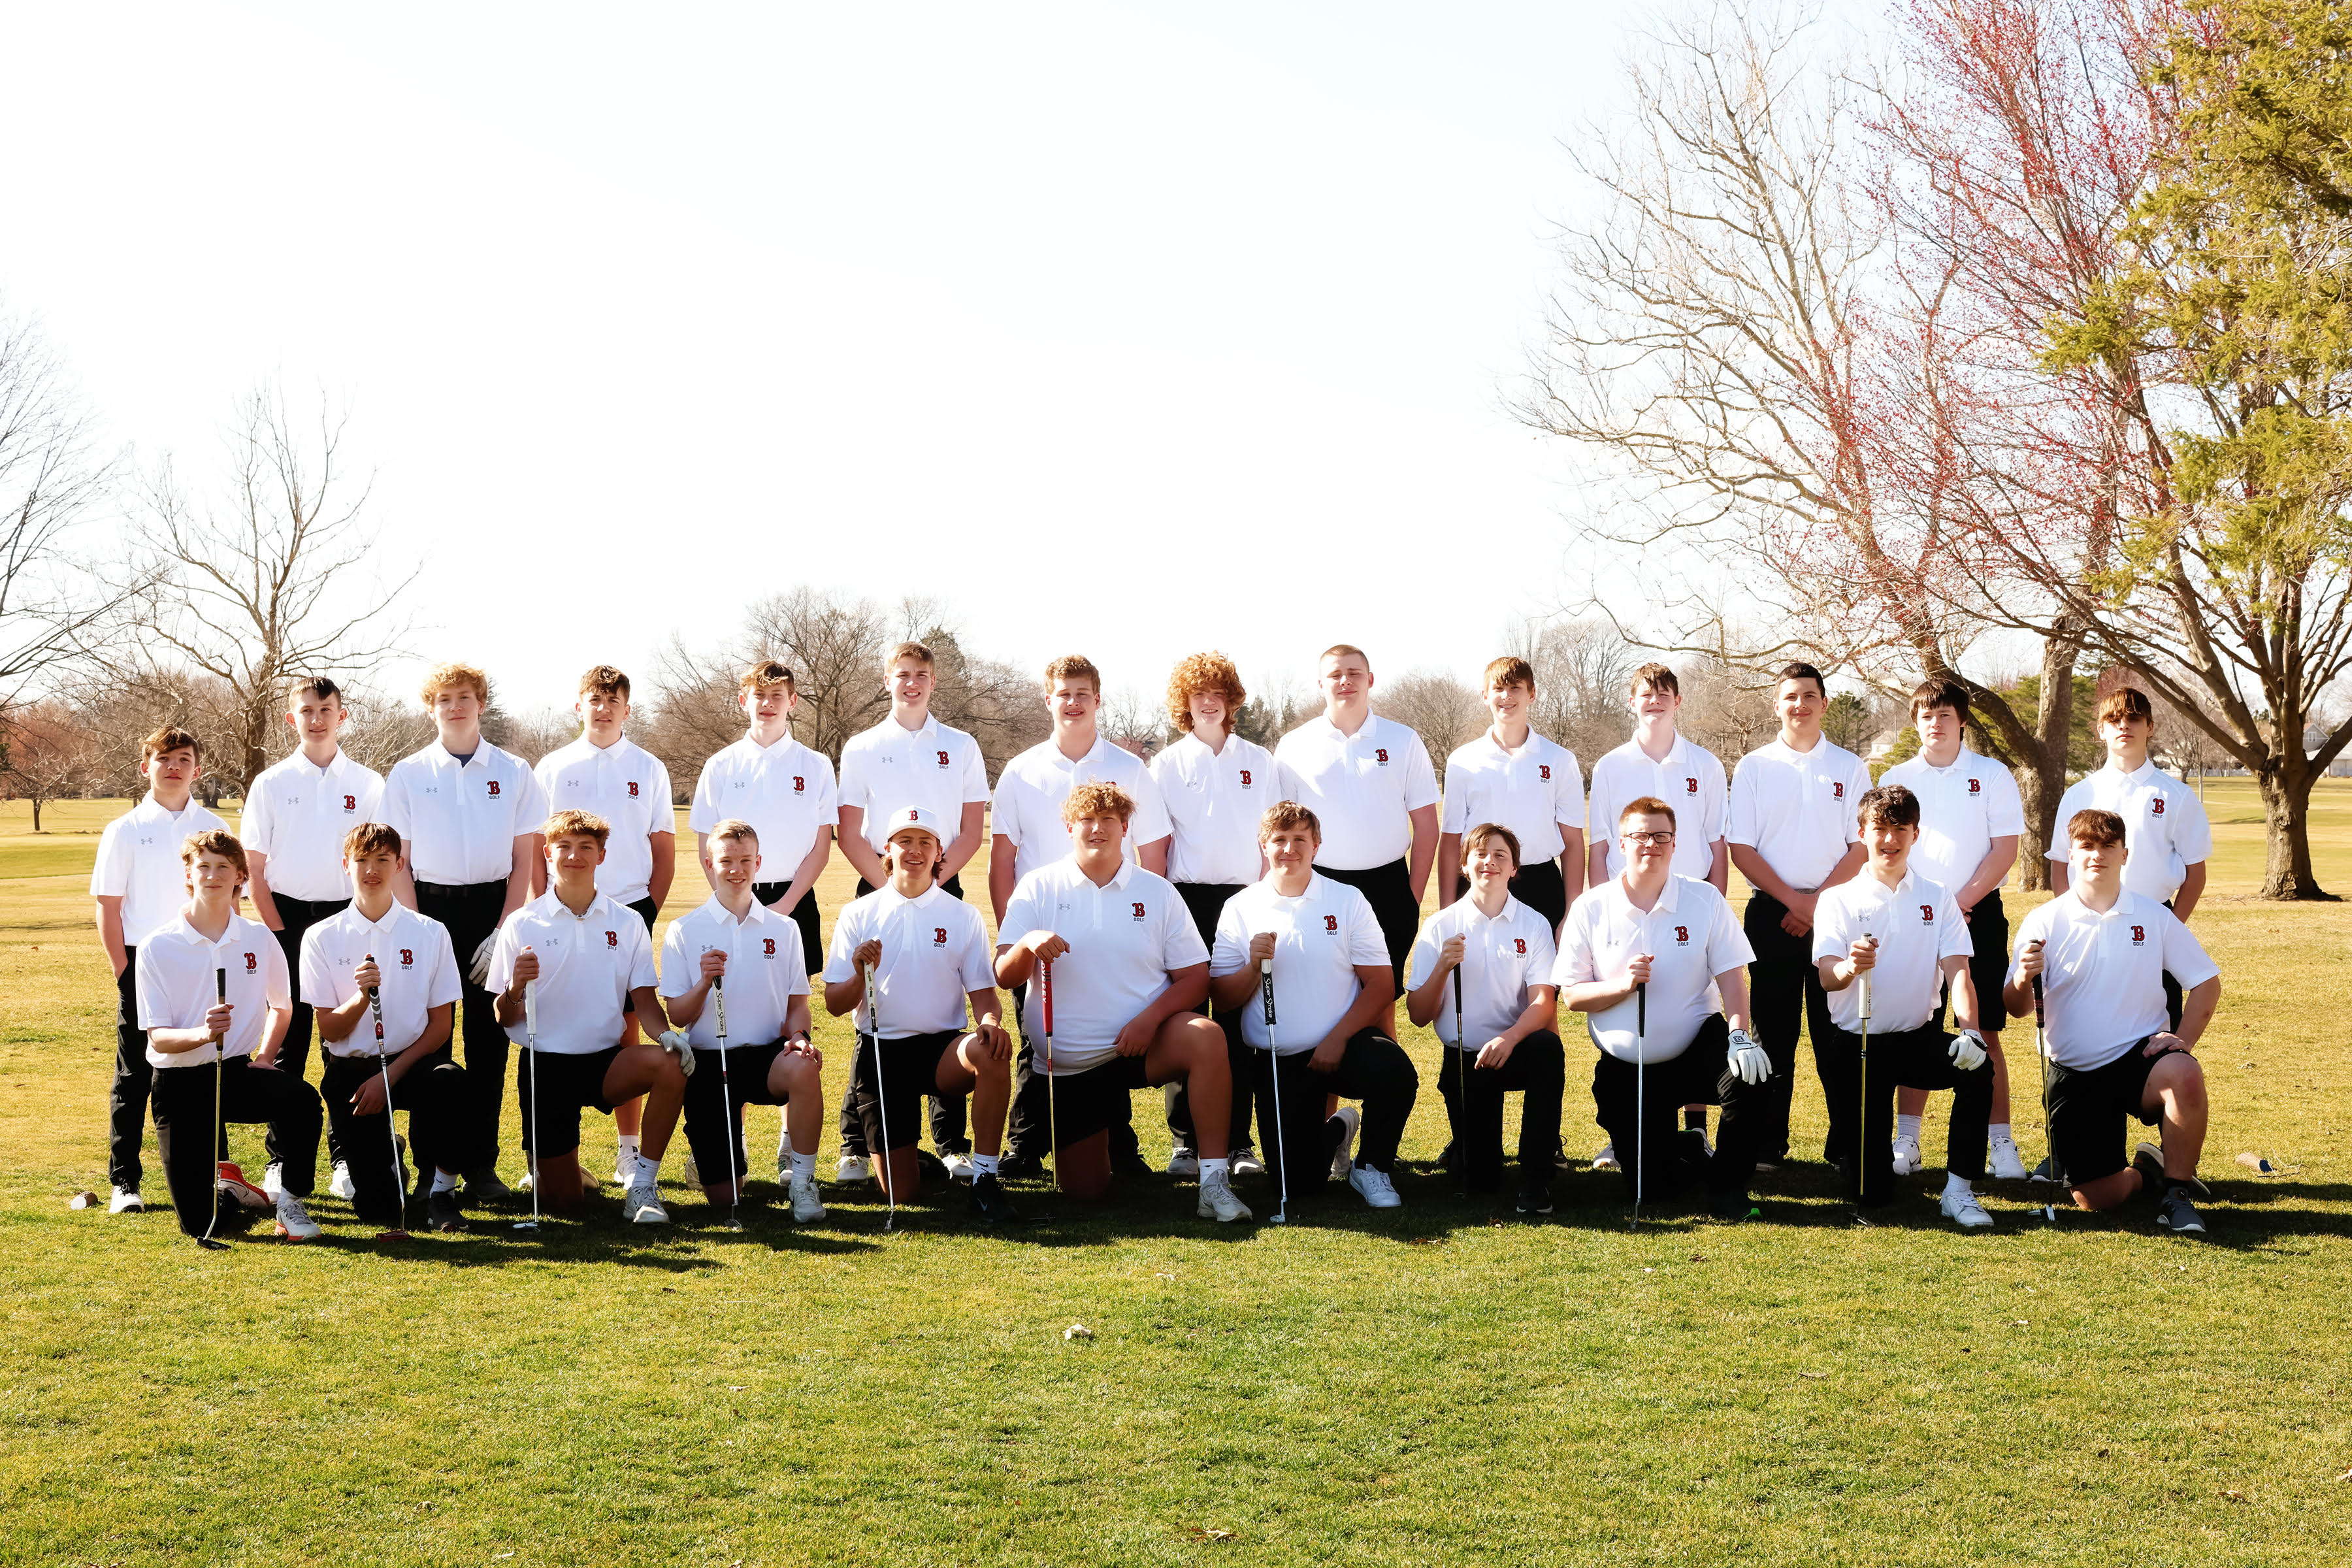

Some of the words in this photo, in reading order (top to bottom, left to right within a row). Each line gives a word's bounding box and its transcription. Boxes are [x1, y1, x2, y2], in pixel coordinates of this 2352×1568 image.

[937, 751, 949, 765] B
[1375, 749, 1389, 762] B
[1240, 770, 1252, 785] B
[1539, 765, 1551, 779] B
[487, 781, 500, 795] B
[628, 782, 639, 796] B
[793, 776, 805, 792] B
[1686, 778, 1698, 793] B
[1834, 782, 1844, 798] B
[1968, 779, 1981, 792] B
[344, 795, 356, 810] B
[2152, 798, 2164, 815] B
[909, 810, 918, 821] B
[1132, 903, 1145, 917] B
[1920, 905, 1934, 921] B
[1324, 915, 1338, 931] B
[605, 931, 618, 947] B
[934, 928, 947, 944] B
[1674, 926, 1689, 942] B
[2131, 926, 2146, 941] B
[763, 939, 776, 955] B
[1514, 939, 1527, 955] B
[244, 953, 257, 970] B
[400, 949, 414, 966] B
